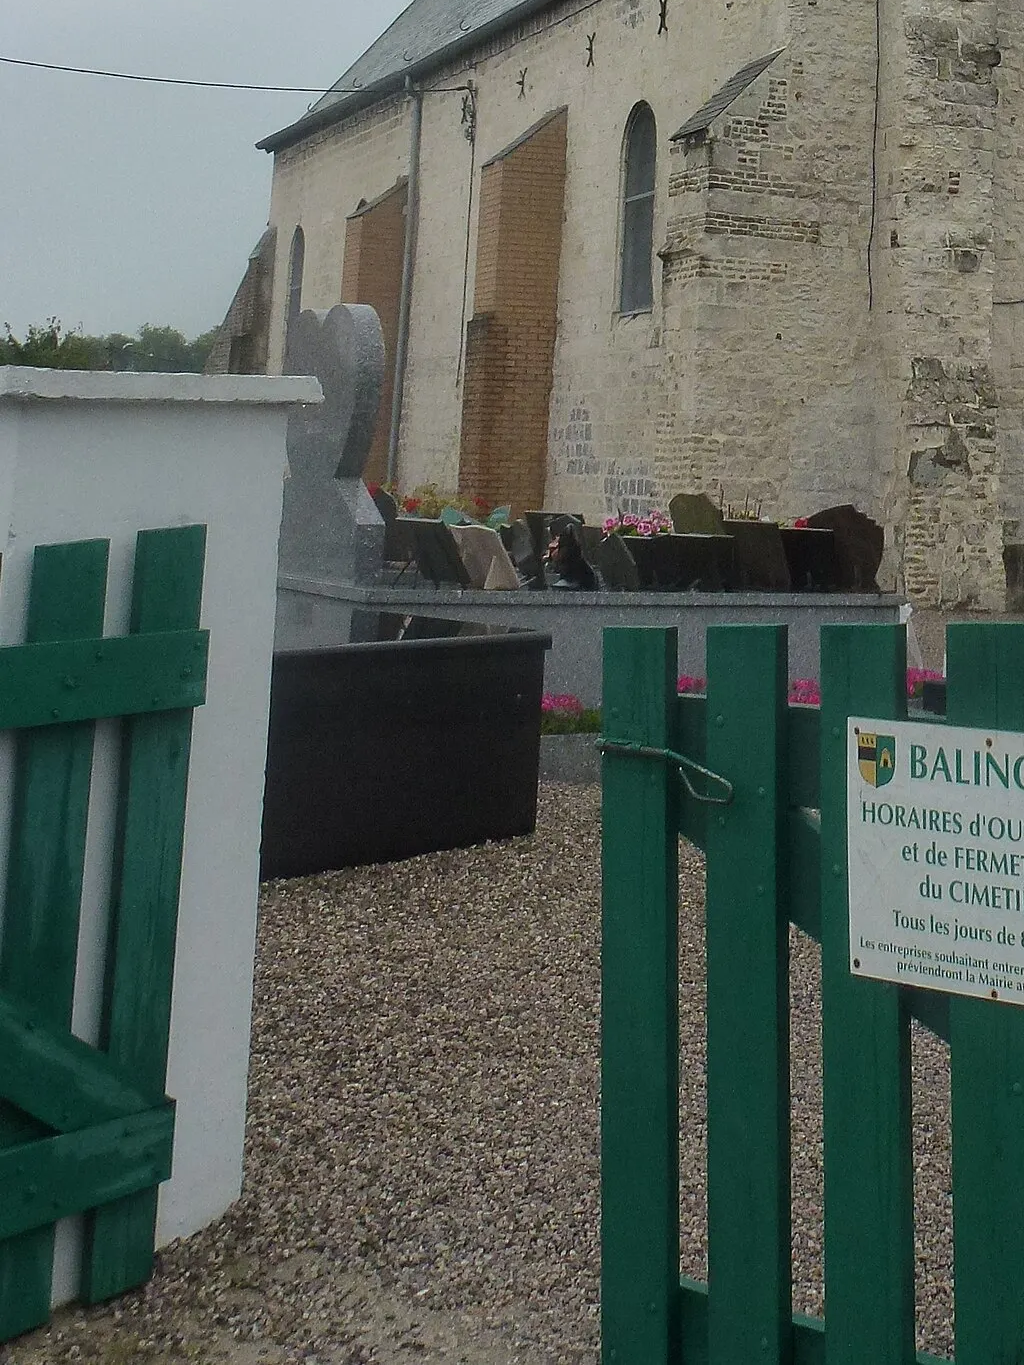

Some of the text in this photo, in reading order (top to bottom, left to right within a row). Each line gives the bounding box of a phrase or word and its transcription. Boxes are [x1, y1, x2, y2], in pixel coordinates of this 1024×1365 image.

[862, 800, 962, 834] HORAIRES
[901, 842, 919, 863] et
[925, 841, 948, 867] de
[919, 874, 942, 900] du
[893, 909, 926, 931] Tous
[930, 914, 950, 935] les
[953, 918, 992, 942] jours
[997, 926, 1016, 946] de
[860, 936, 875, 950] Les
[878, 941, 932, 959] entreprises
[934, 950, 989, 970] souhaitant
[992, 960, 1024, 975] entrer
[897, 959, 962, 982] préviendront
[966, 969, 976, 984] la
[978, 973, 1013, 990] Mairie
